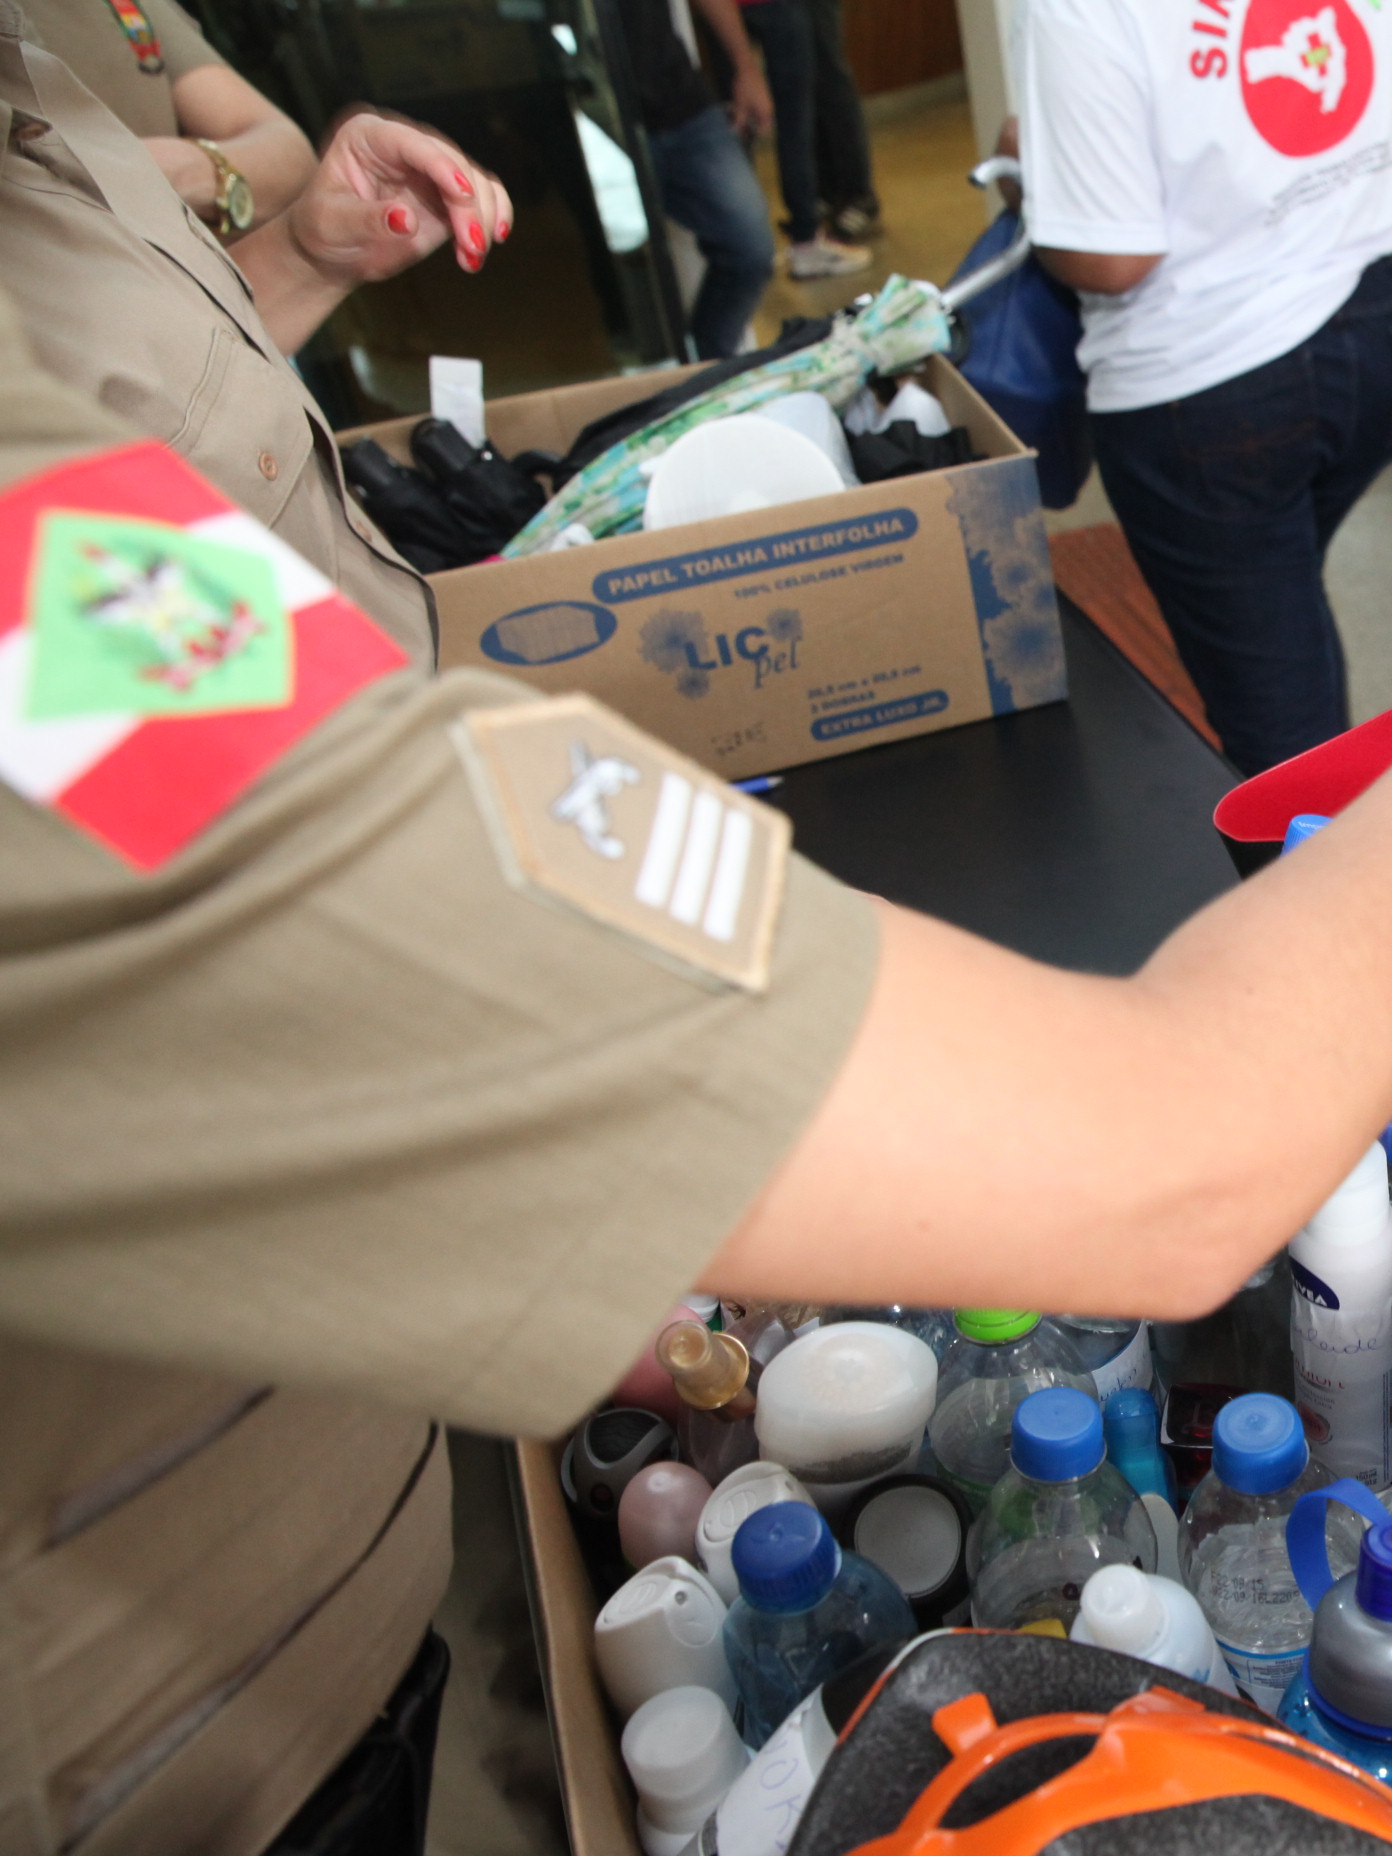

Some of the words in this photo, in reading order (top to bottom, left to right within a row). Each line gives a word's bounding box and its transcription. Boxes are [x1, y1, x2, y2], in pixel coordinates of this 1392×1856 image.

[607, 569, 678, 596] PAPEL
[681, 549, 769, 579] TOALHA
[772, 517, 905, 560] INTERFOLHA
[683, 626, 770, 671] LIC
[753, 635, 803, 689] pel
